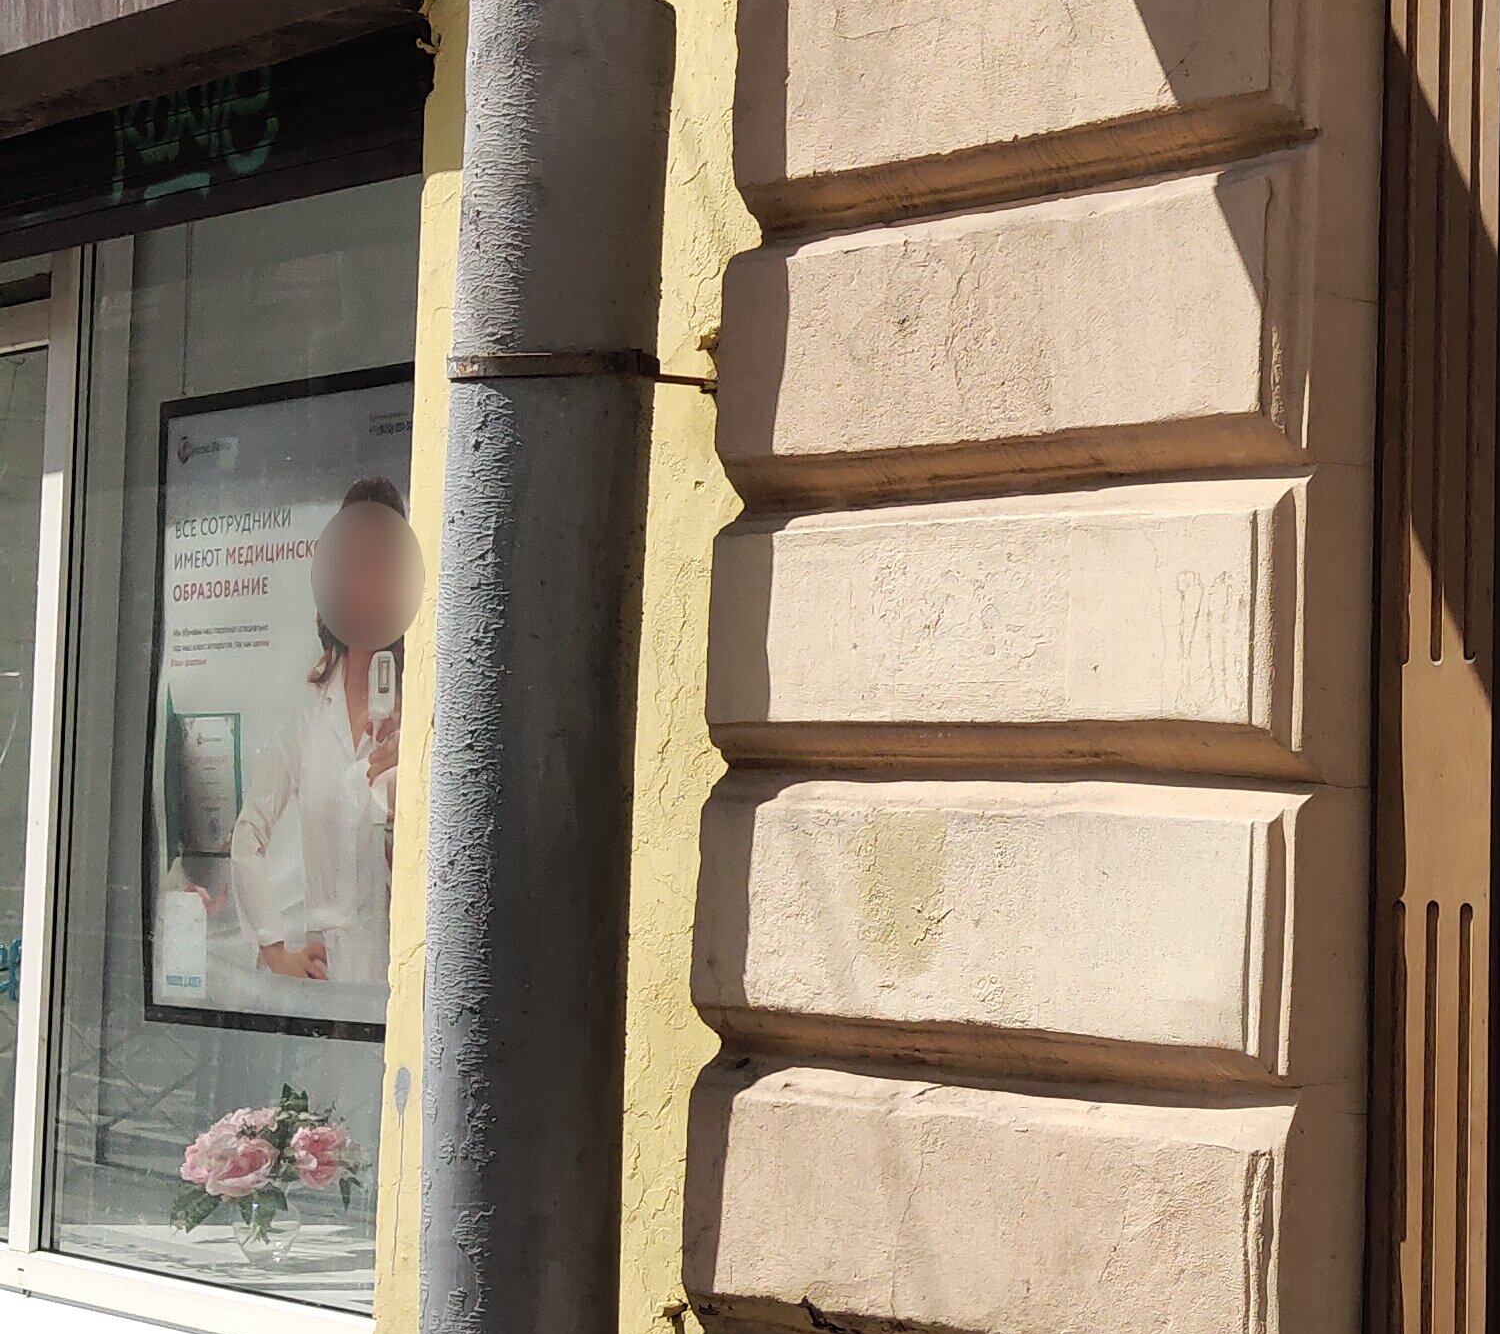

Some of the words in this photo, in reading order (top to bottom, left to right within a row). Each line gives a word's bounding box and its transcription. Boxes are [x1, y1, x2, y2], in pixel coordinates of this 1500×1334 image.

[175, 519, 197, 539] ВСЕ
[200, 509, 292, 536] СОТРУДНИКИ
[174, 548, 222, 570] ИМЕЮТ
[226, 538, 319, 566] МЕДИЦИНСК
[173, 576, 268, 602] ОБРАЗОВАНИЕ
